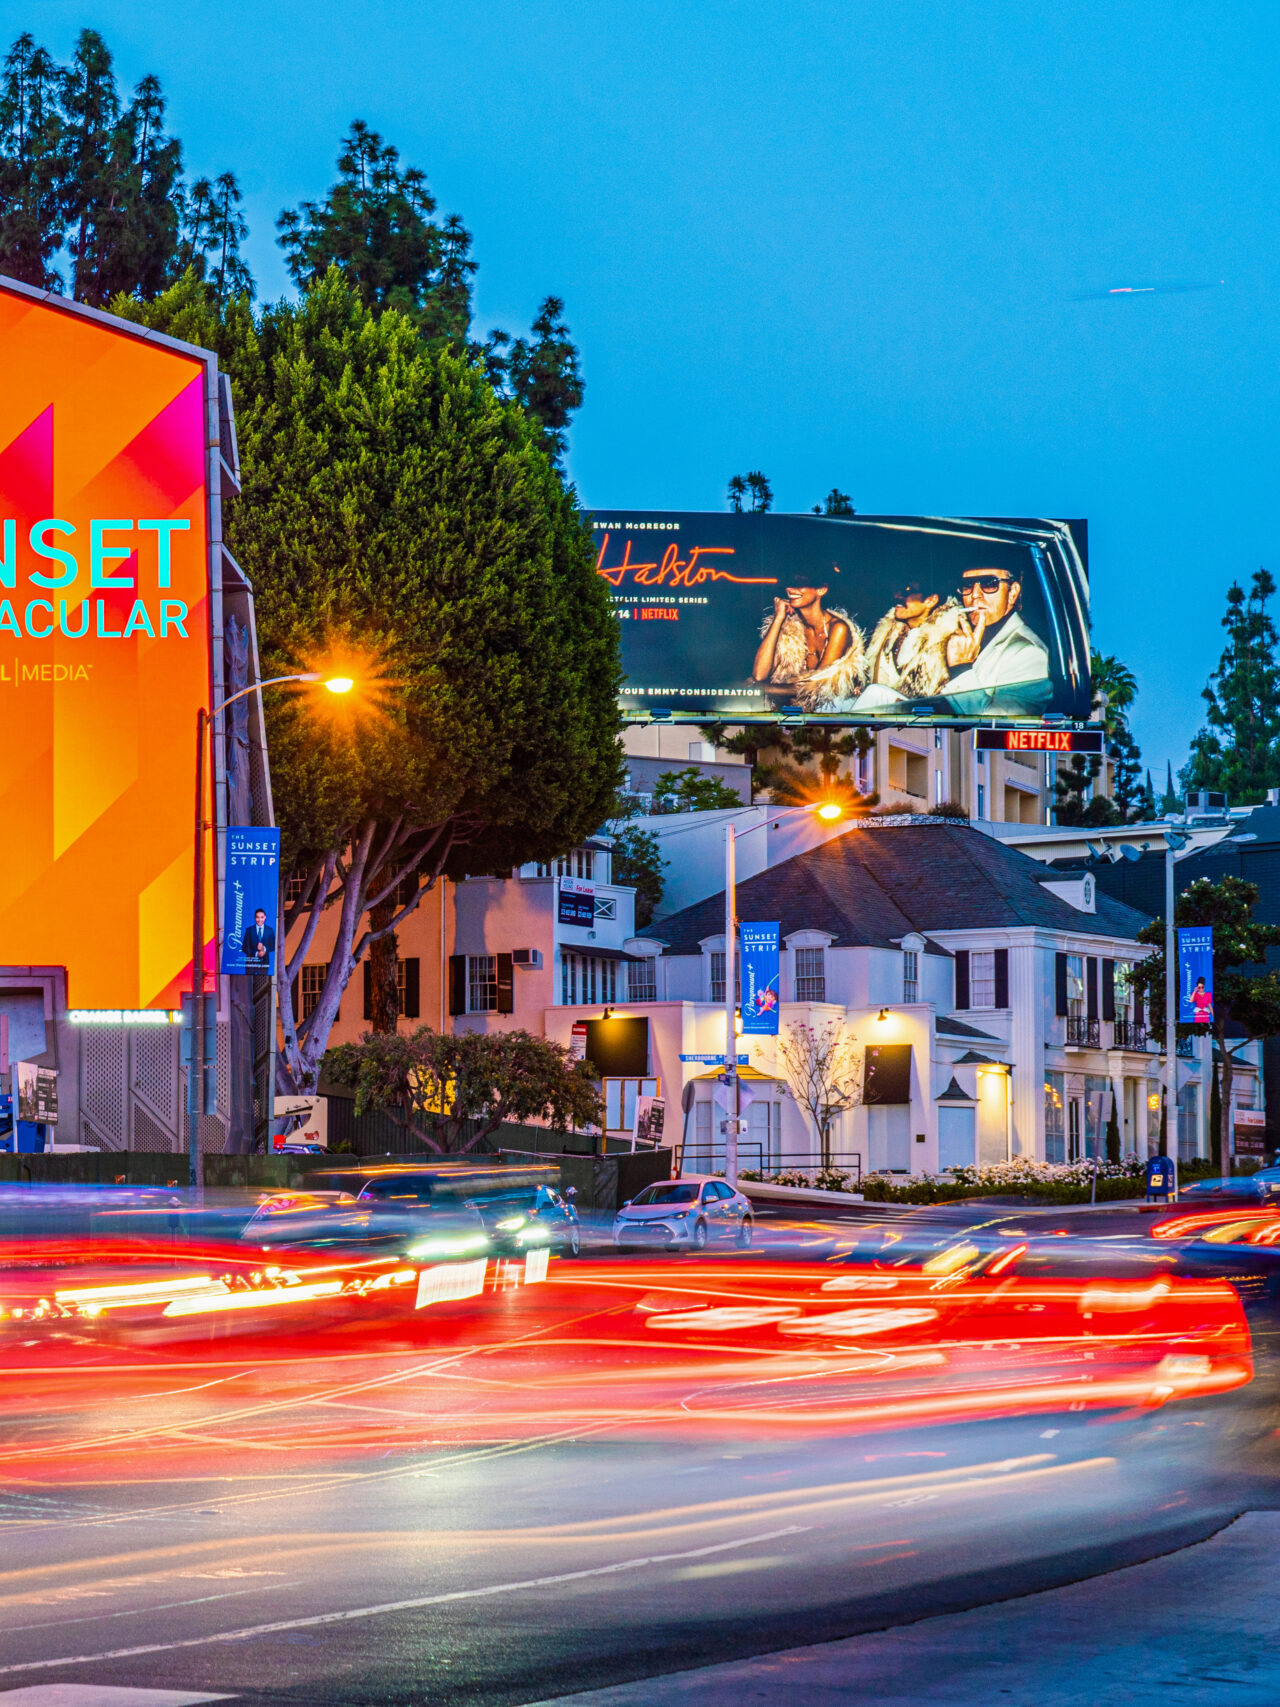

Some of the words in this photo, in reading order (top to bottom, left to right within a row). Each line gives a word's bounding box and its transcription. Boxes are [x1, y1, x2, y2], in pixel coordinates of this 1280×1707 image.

[593, 522, 621, 530] EWAN
[625, 522, 680, 530] McGREGOR
[596, 533, 778, 587] Halston
[641, 608, 679, 620] NETFLIX
[1074, 722, 1084, 730] 18
[1007, 731, 1071, 751] NETFLIX
[231, 842, 277, 851] SUNSET
[231, 856, 276, 866] STRIP
[744, 933, 777, 941] SUNSET
